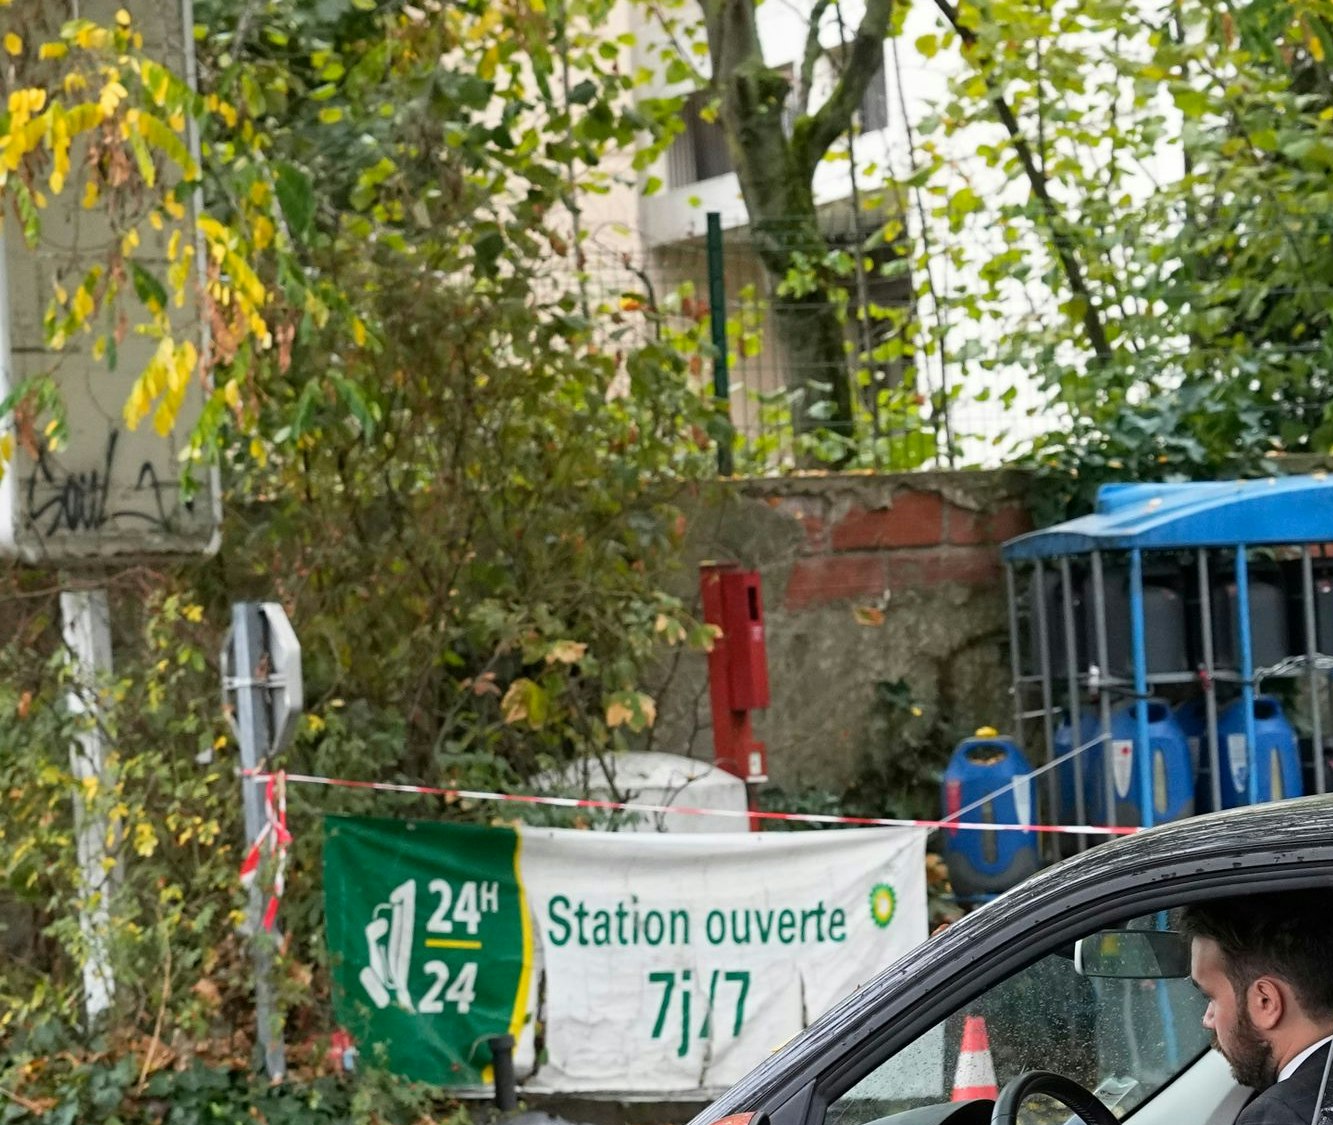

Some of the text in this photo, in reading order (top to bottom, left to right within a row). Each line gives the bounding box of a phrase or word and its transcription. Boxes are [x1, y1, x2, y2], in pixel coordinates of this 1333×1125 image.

[426, 878, 499, 935] 24H
[548, 894, 847, 946] Station ouverte
[418, 959, 478, 1014] 24
[649, 970, 750, 1057] 7j/7
